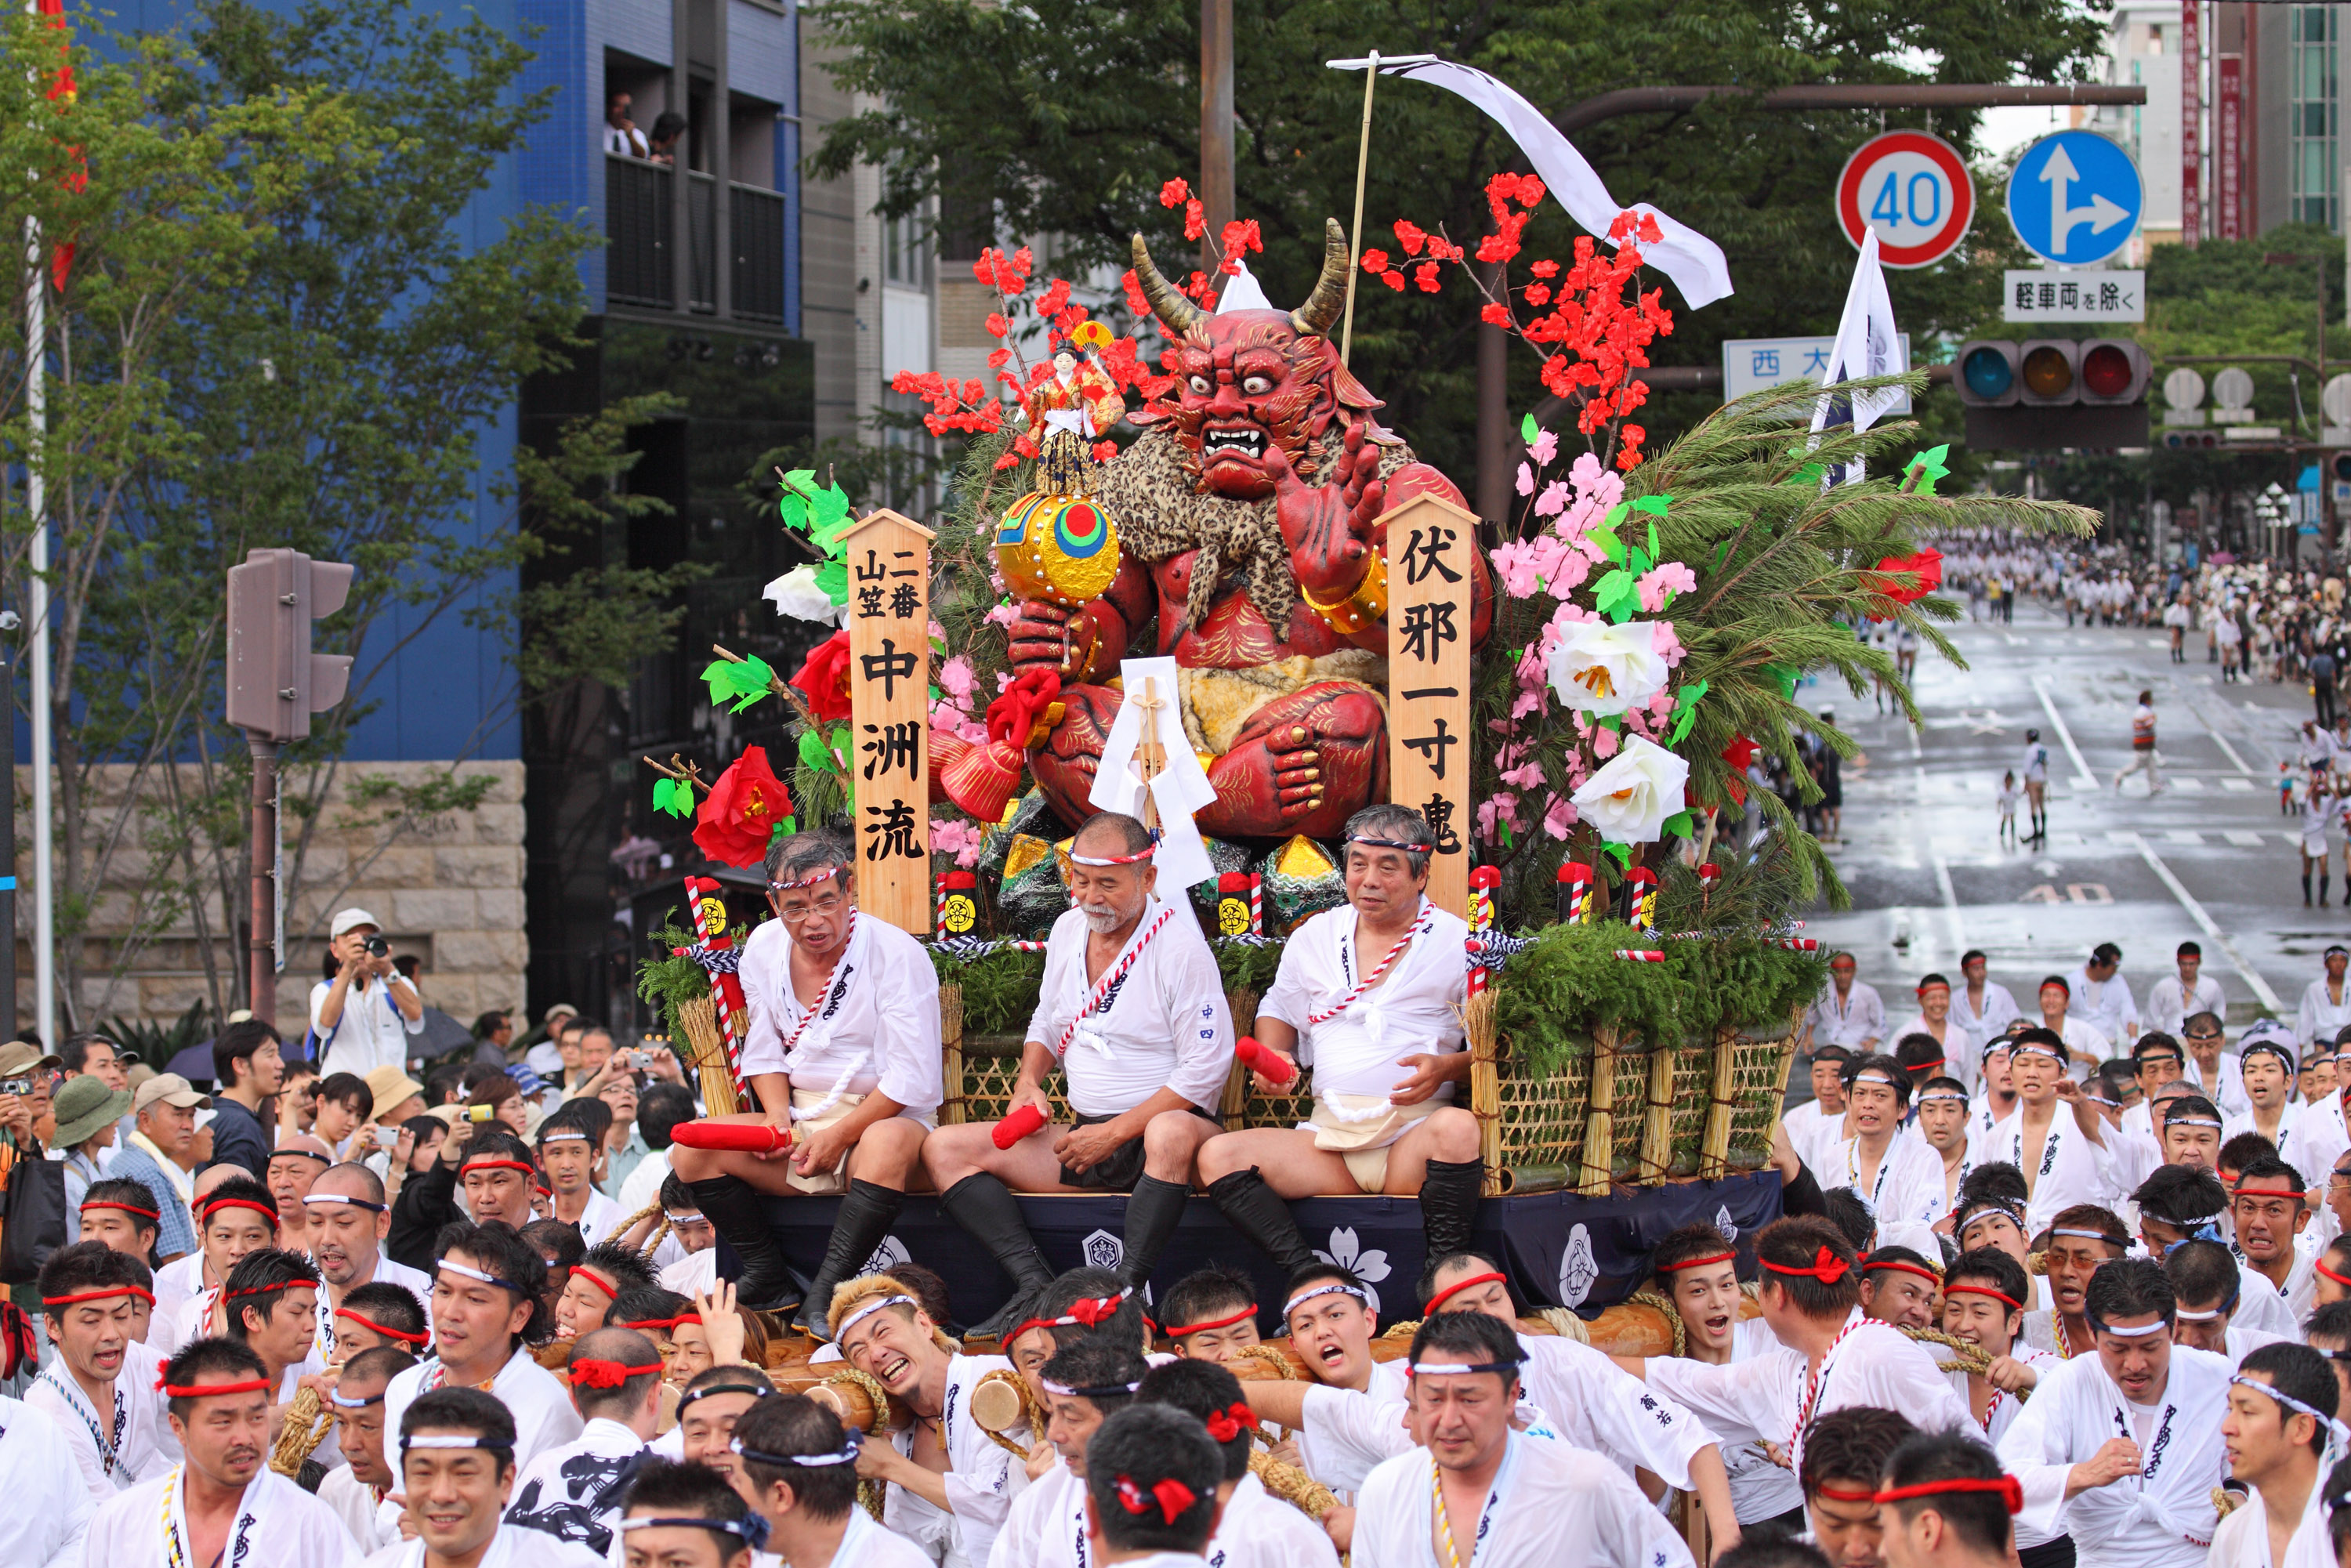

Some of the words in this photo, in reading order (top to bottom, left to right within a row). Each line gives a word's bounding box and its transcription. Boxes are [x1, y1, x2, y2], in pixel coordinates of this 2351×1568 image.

[1871, 171, 1940, 228] 40
[2016, 281, 2135, 311] 軽車両を除く
[1751, 347, 1830, 377] 西大
[855, 550, 887, 619] 山笠
[889, 551, 924, 618] 二番
[1399, 525, 1463, 856] 伏邪一寸魂
[860, 639, 926, 862] 中洲流
[2017, 882, 2116, 906] 40
[1200, 1004, 1214, 1039] 中四
[1922, 1197, 1938, 1222] 中五
